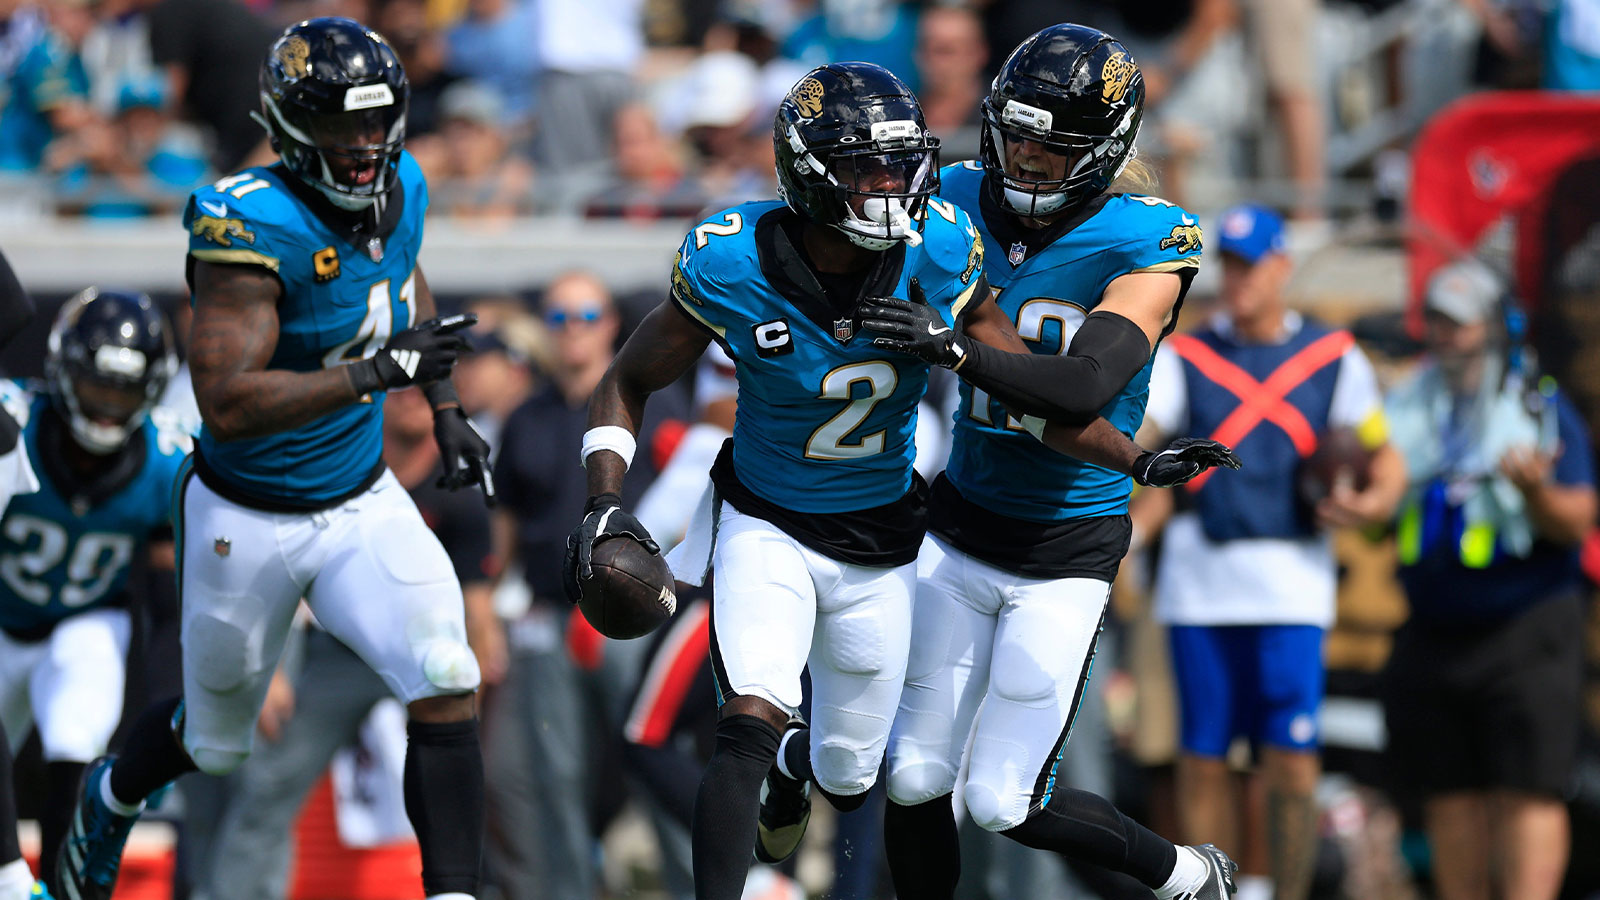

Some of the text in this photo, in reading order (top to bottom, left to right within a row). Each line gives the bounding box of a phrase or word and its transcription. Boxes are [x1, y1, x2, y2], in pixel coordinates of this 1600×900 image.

[694, 211, 744, 251] 2
[313, 246, 339, 276] C
[755, 320, 790, 350] C
[803, 359, 898, 461] 2
[0, 513, 135, 609] 29
